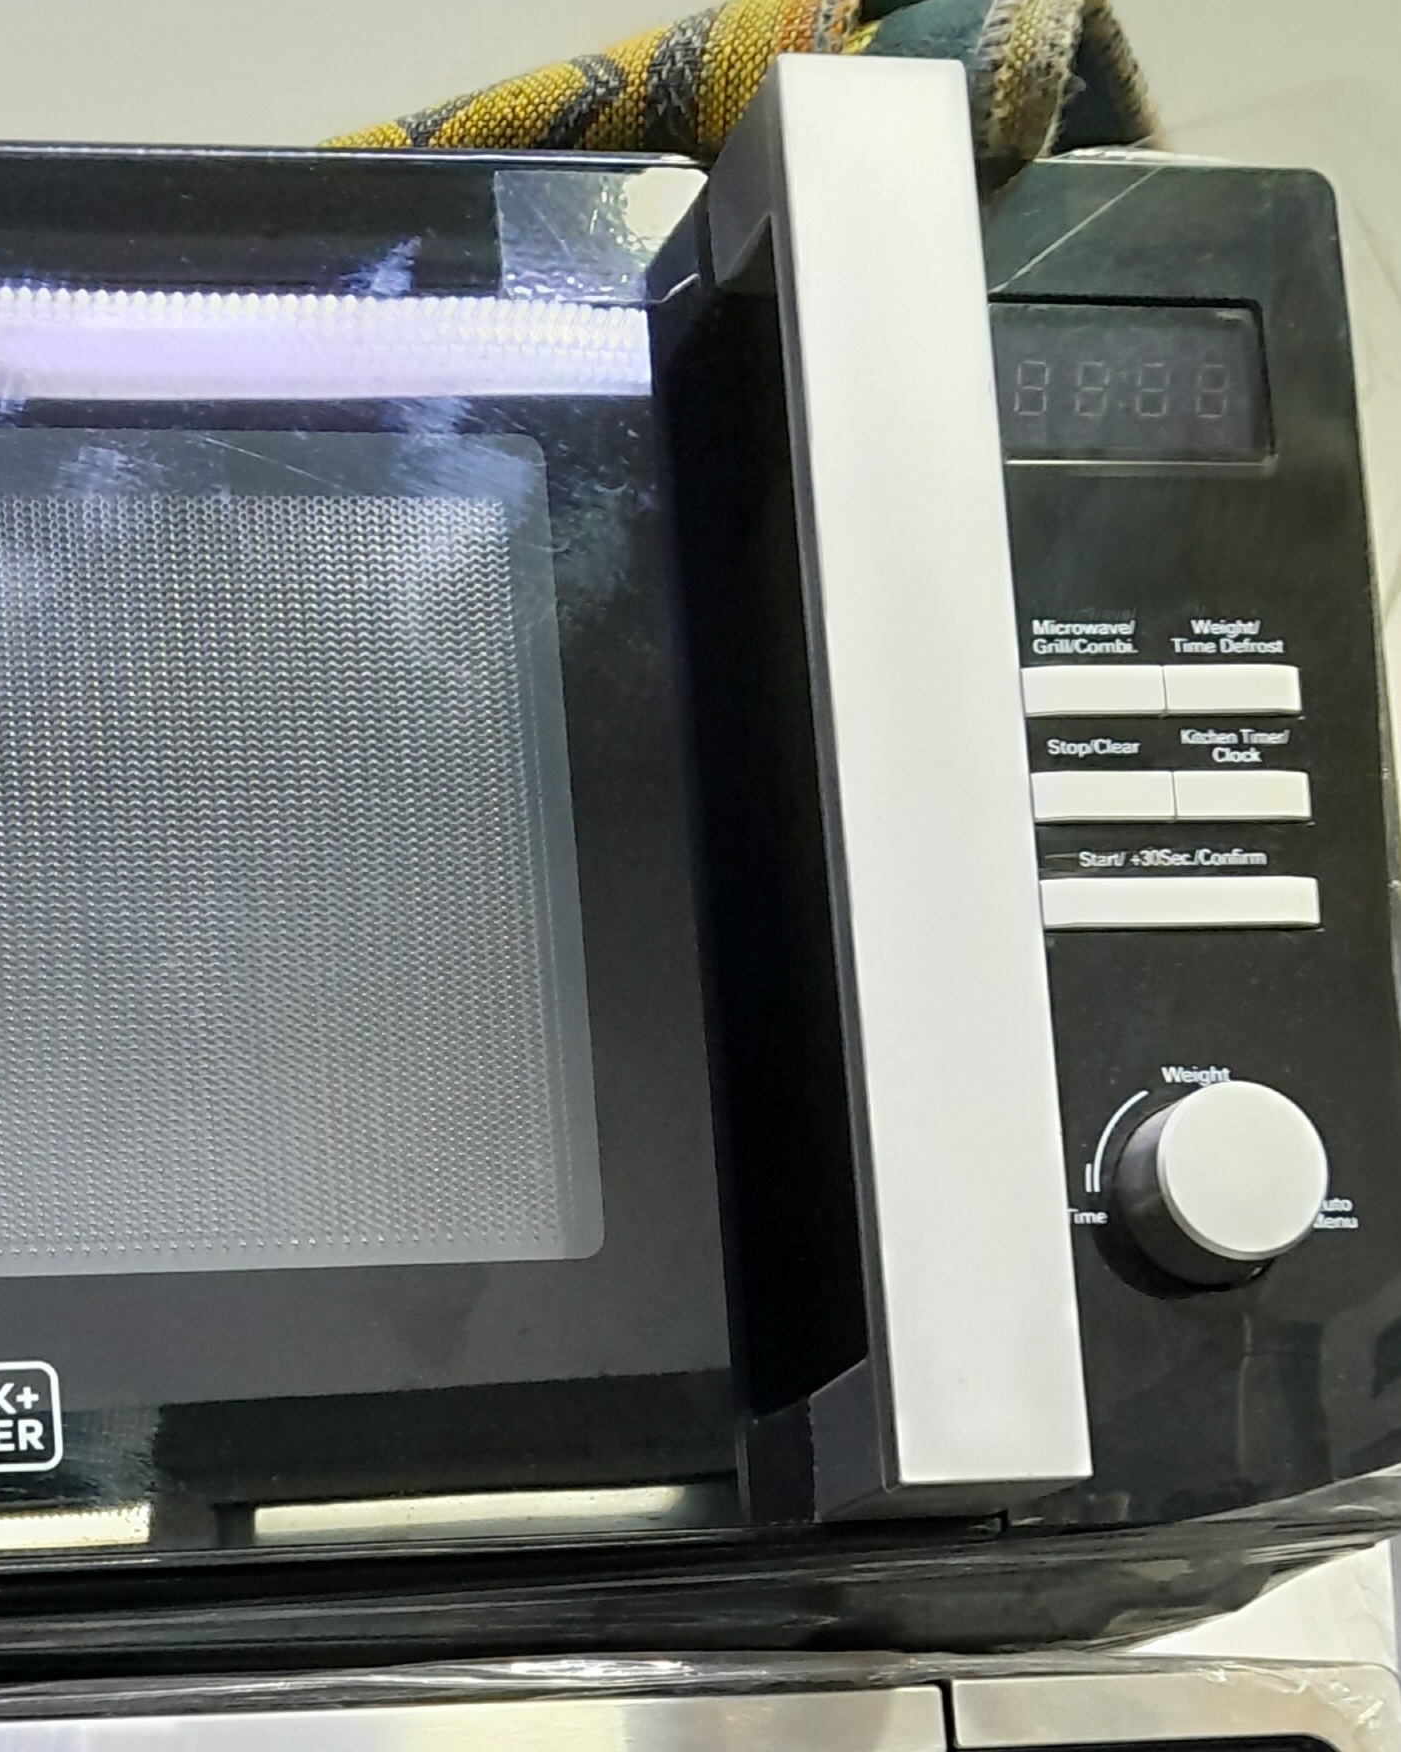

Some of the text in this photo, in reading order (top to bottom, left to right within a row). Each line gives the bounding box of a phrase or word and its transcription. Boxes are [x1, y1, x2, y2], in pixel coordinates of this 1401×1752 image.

[1032, 619, 1135, 636] Microwave/
[1191, 619, 1261, 637] Weight/
[1033, 638, 1139, 655] Grill/Combi.
[1171, 638, 1285, 654] Time Defrost
[1180, 729, 1238, 744] Kitchen
[1047, 739, 1141, 757] Stop/Clear
[1212, 747, 1262, 763] Clock
[1079, 851, 1127, 867] Start/
[1161, 1066, 1231, 1087] Weight
[1319, 1197, 1353, 1212] uto
